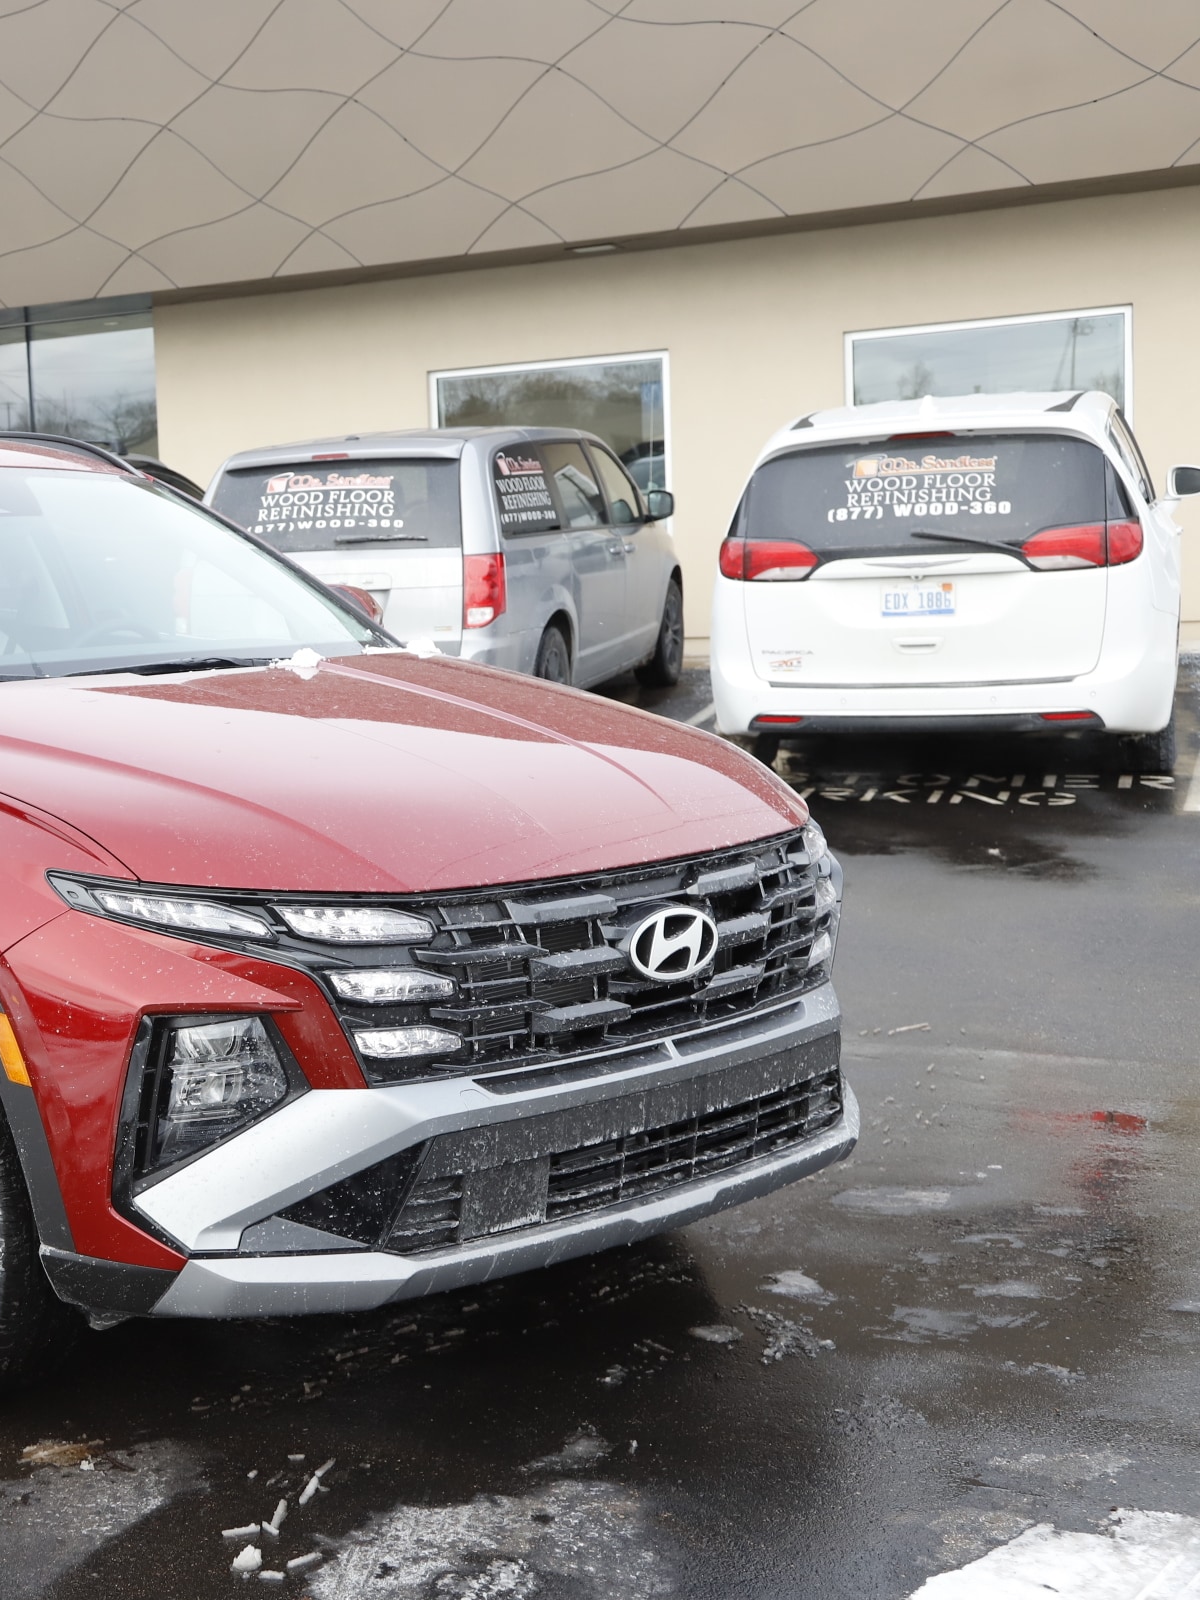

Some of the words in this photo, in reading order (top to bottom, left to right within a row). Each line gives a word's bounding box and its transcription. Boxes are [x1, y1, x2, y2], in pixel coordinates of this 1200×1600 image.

[921, 455, 995, 469] Sandless
[496, 477, 523, 493] WOOD
[521, 476, 547, 491] FLOOR
[845, 475, 917, 493] WOOD
[923, 473, 996, 489] FLOOR
[260, 491, 324, 508] WOOD
[328, 490, 395, 504] FLOOR
[502, 491, 552, 510] REFINISHING
[847, 487, 992, 507] REFINISHING
[258, 503, 394, 522] REFINISHING
[827, 505, 883, 523] (877)
[893, 501, 1011, 517] WOOD-360
[885, 593, 908, 610] EDX
[918, 592, 951, 608] 1886
